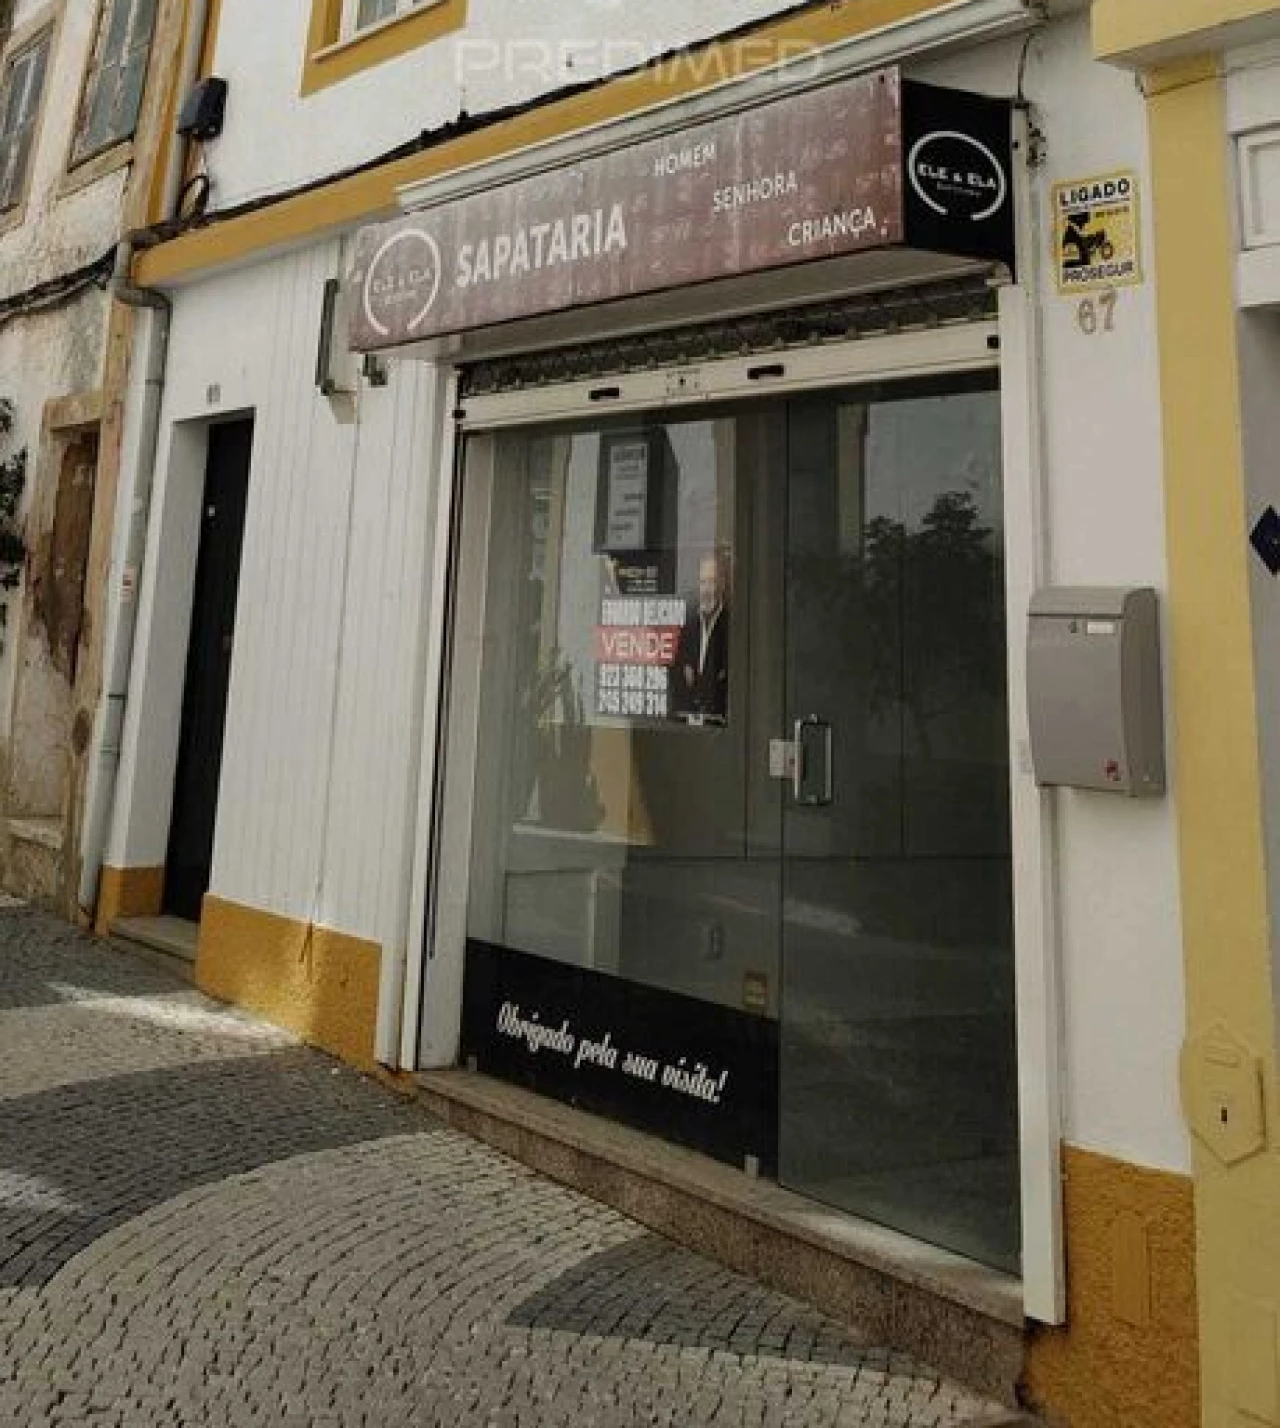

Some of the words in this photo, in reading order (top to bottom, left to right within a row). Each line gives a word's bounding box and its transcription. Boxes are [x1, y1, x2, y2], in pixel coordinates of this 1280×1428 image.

[654, 142, 716, 176] HOMEM
[918, 163, 948, 180] ELE
[967, 172, 997, 190] ELA
[712, 169, 798, 213] SENHORA
[1059, 177, 1131, 207] LIGADO
[788, 205, 877, 247] CRIANÇA
[455, 203, 628, 289] SAPATARIA
[1063, 261, 1135, 284] PROSEGUR
[1078, 289, 1118, 335] 67
[601, 631, 673, 660] VENDE
[496, 1001, 576, 1054] Obrigado
[574, 1032, 619, 1069] pela
[622, 1052, 659, 1081] sua
[660, 1057, 729, 1103] visita!
